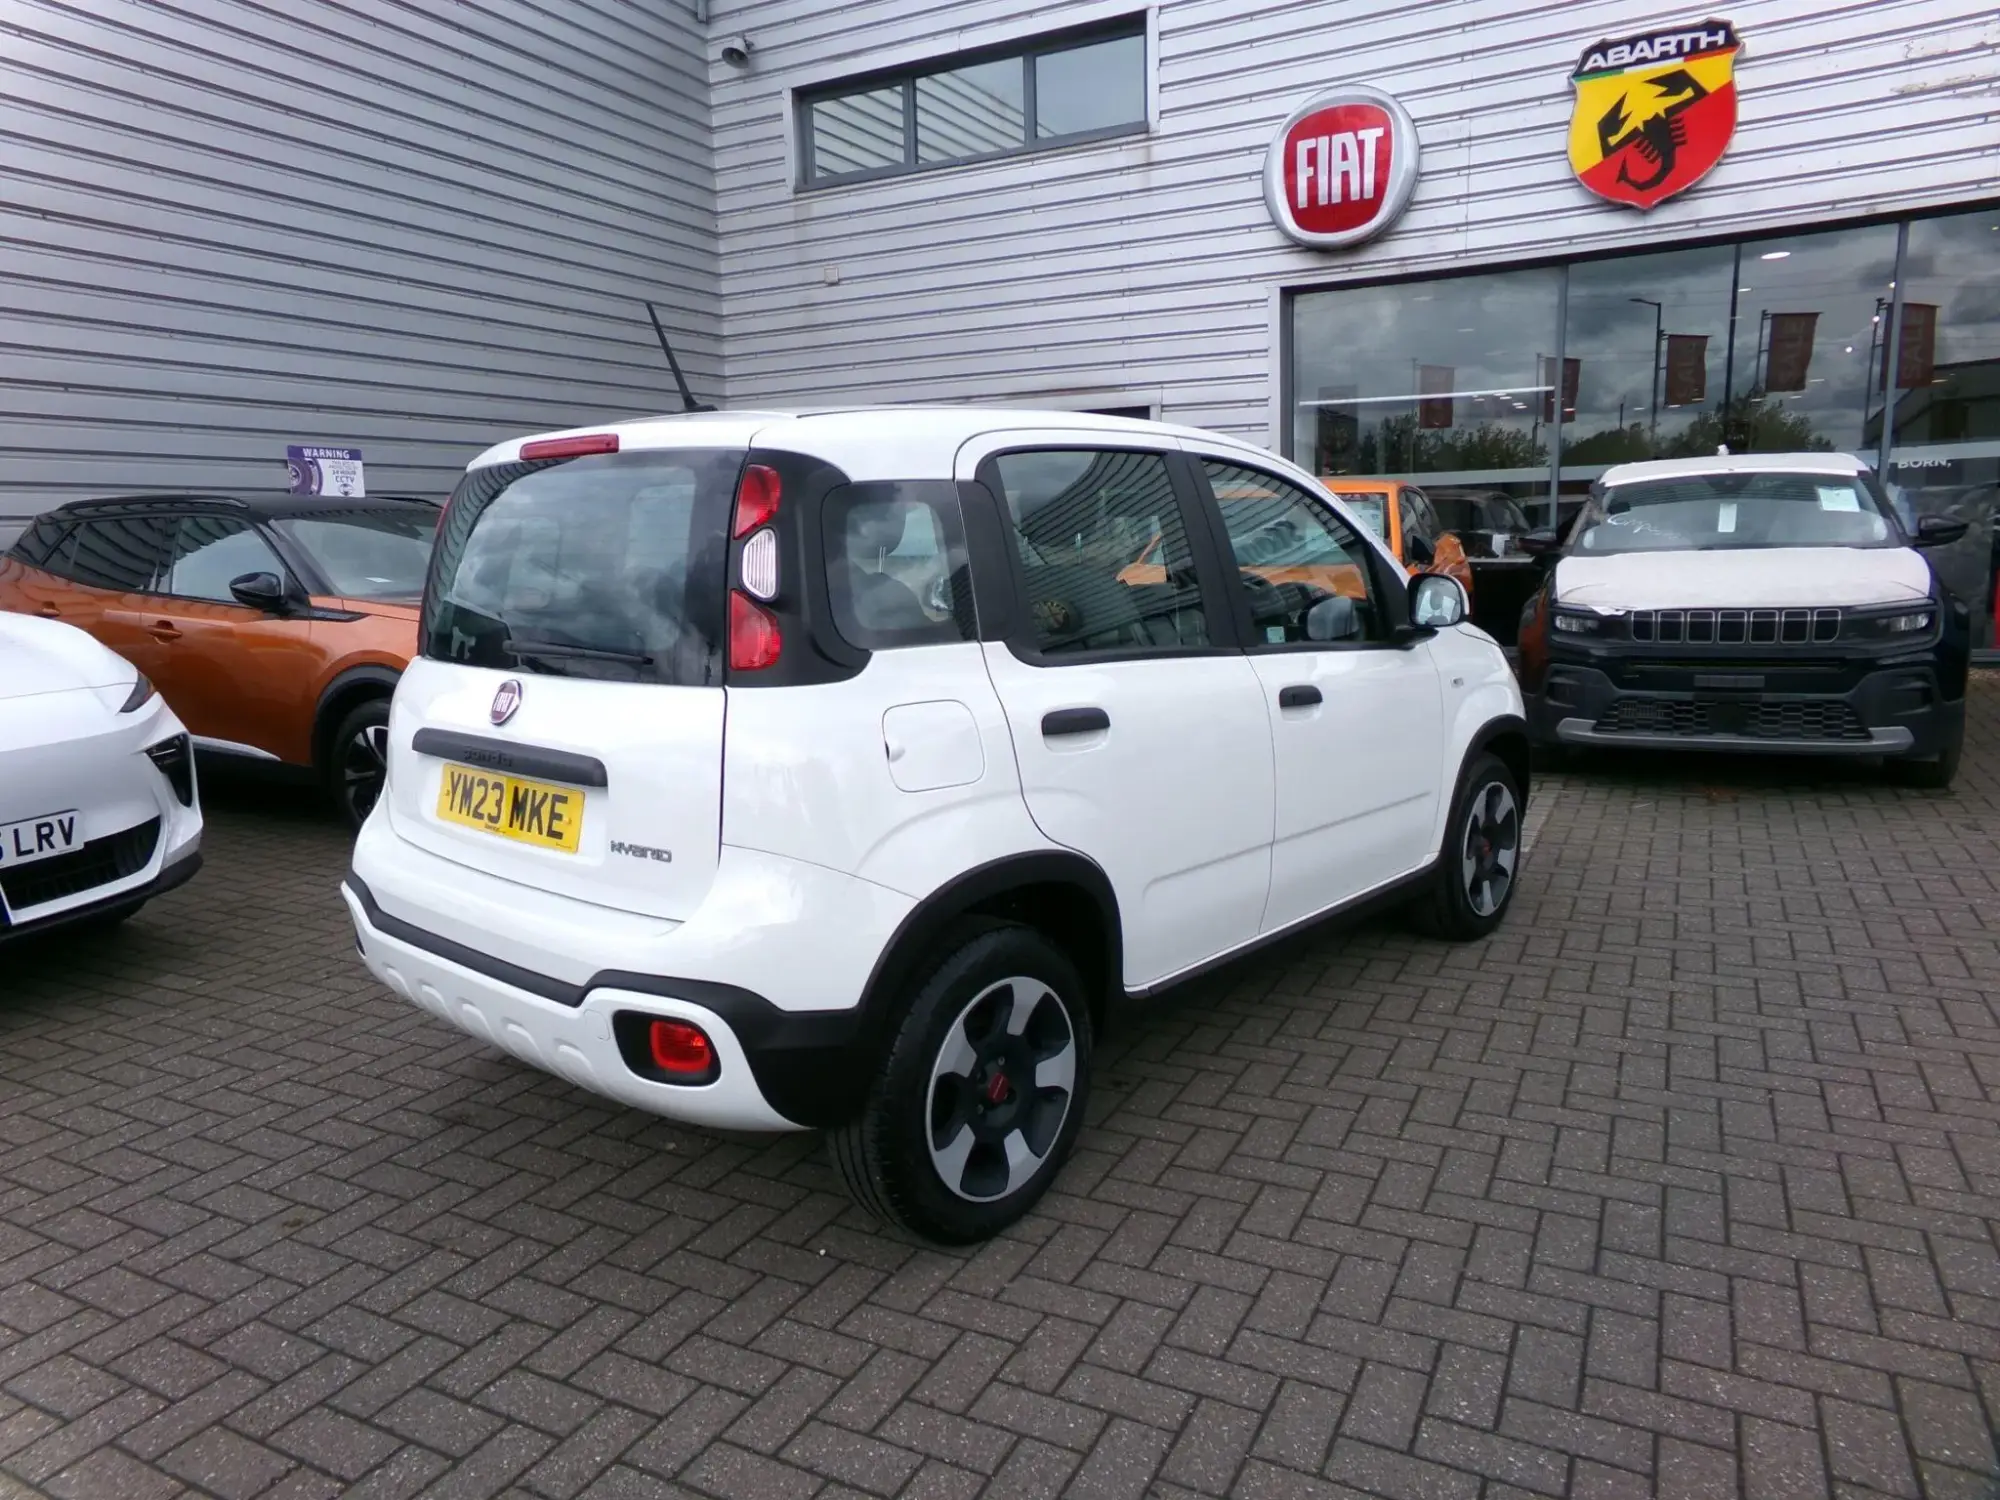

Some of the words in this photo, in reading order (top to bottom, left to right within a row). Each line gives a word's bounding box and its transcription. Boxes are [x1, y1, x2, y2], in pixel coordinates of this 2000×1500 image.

[1582, 29, 1726, 73] ABARTH
[1295, 126, 1384, 209] FIAT
[302, 448, 350, 460] WARNING
[449, 770, 505, 825] YM23
[508, 785, 569, 840] MKE
[13, 815, 75, 857] LRV
